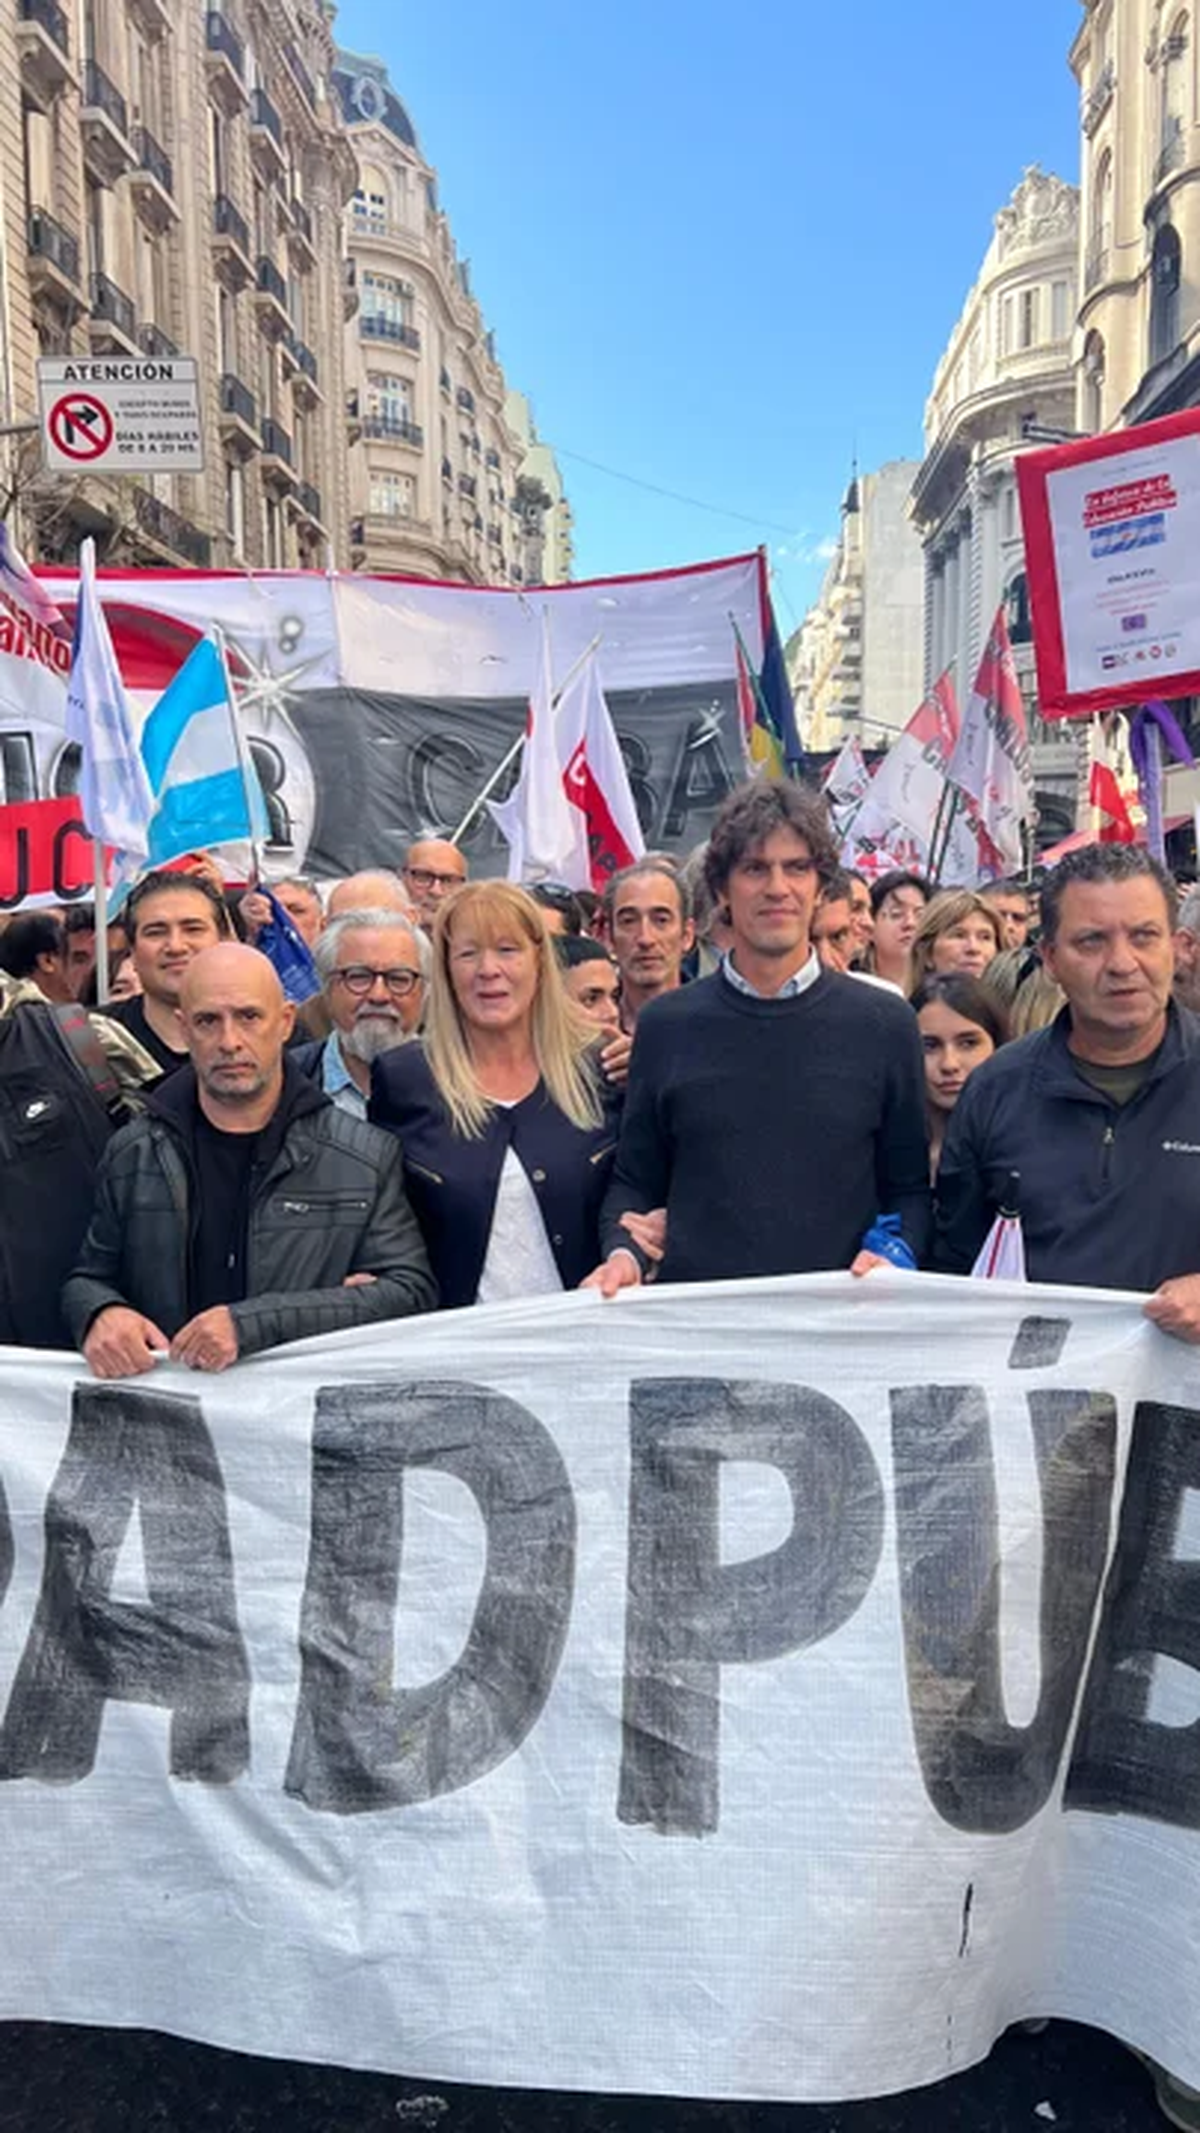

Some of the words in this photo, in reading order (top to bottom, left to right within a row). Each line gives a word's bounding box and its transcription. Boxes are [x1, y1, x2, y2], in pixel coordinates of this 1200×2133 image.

[64, 362, 173, 380] ATENCIÓN
[118, 444, 134, 454] DE
[150, 444, 158, 453] A
